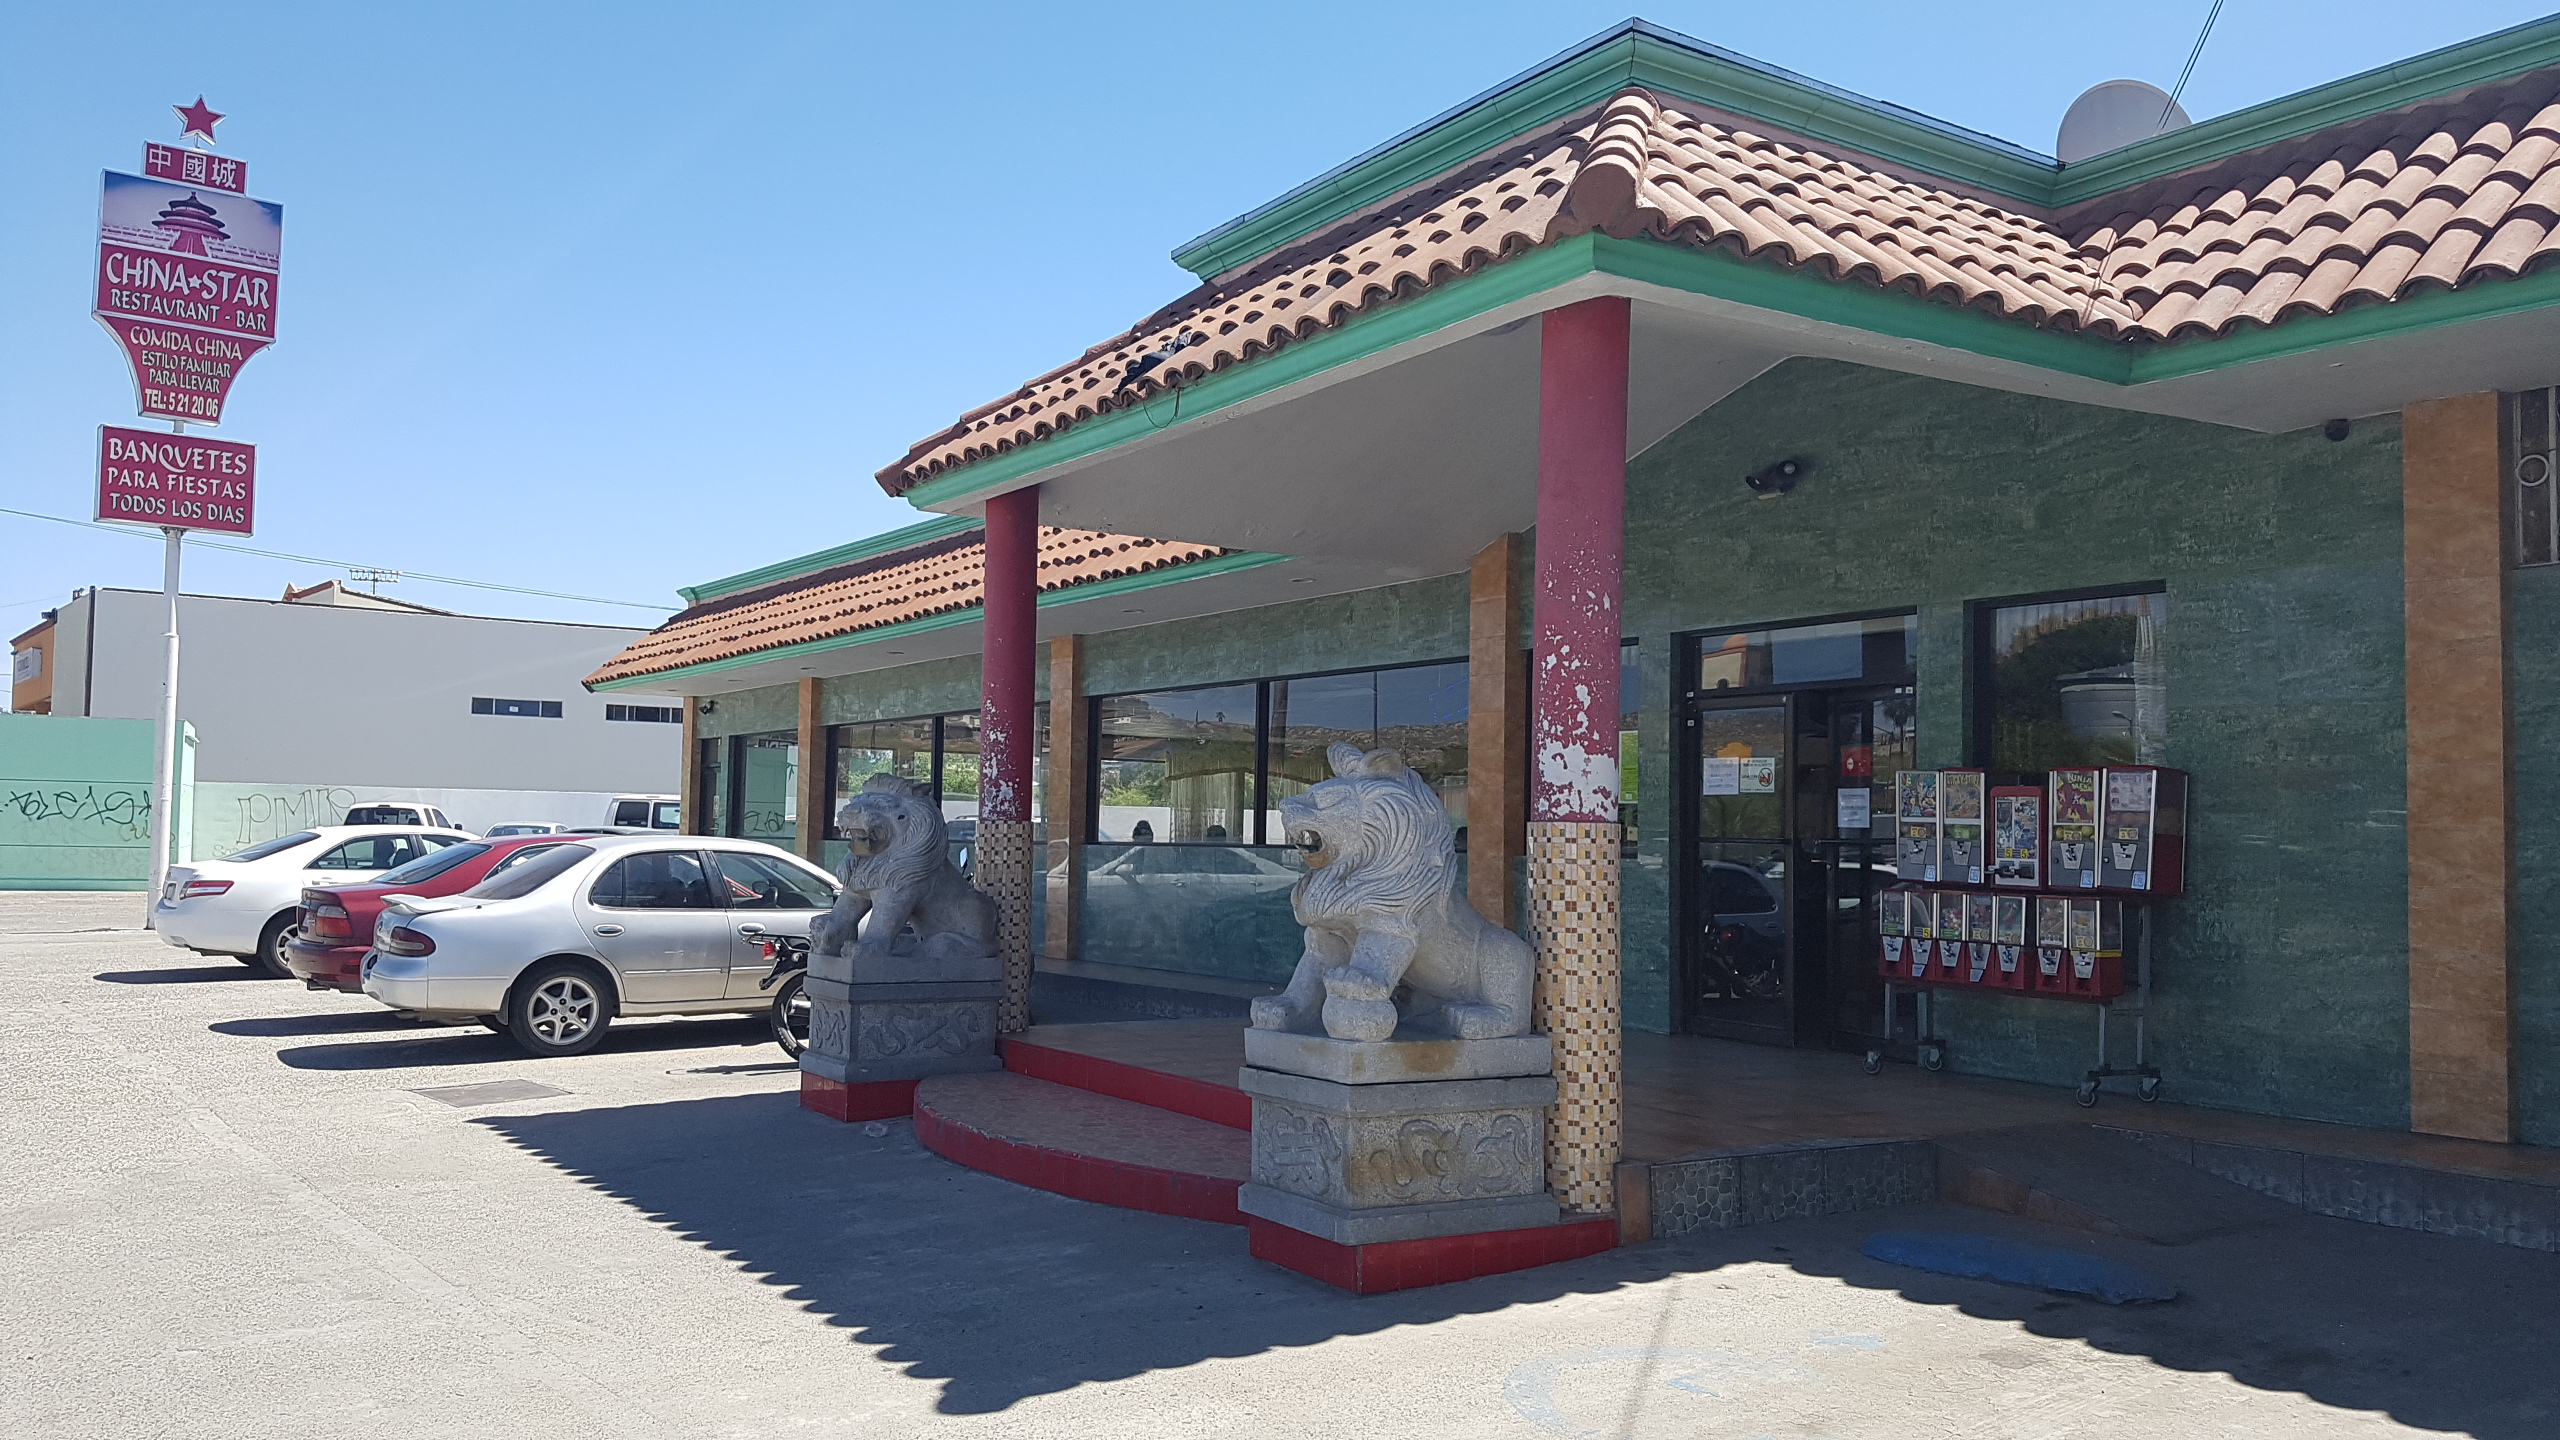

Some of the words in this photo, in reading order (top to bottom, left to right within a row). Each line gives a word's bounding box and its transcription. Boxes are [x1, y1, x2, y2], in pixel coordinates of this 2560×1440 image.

[148, 145, 237, 190] 中國城
[106, 252, 190, 296] CHINA
[200, 268, 270, 310] STAR
[110, 288, 221, 324] RESTAURANT
[235, 310, 267, 332] BAR
[130, 325, 193, 353] COMIDA
[195, 336, 243, 361] CHINA
[141, 350, 179, 370] ESTILO
[180, 359, 231, 379] FAMILIAR
[149, 368, 178, 388] PARA
[180, 375, 220, 394] LLEVAR
[145, 388, 167, 410] TEL:
[168, 393, 176, 411] 5
[177, 394, 189, 413] 21
[191, 397, 204, 415] 20
[206, 398, 219, 418] 06
[108, 437, 247, 476] BANQUETES
[108, 467, 160, 490] PARA
[167, 474, 246, 500] FIESTAS
[109, 492, 166, 515] TODOS
[171, 499, 202, 519] LOS
[206, 503, 245, 524] DIAS
